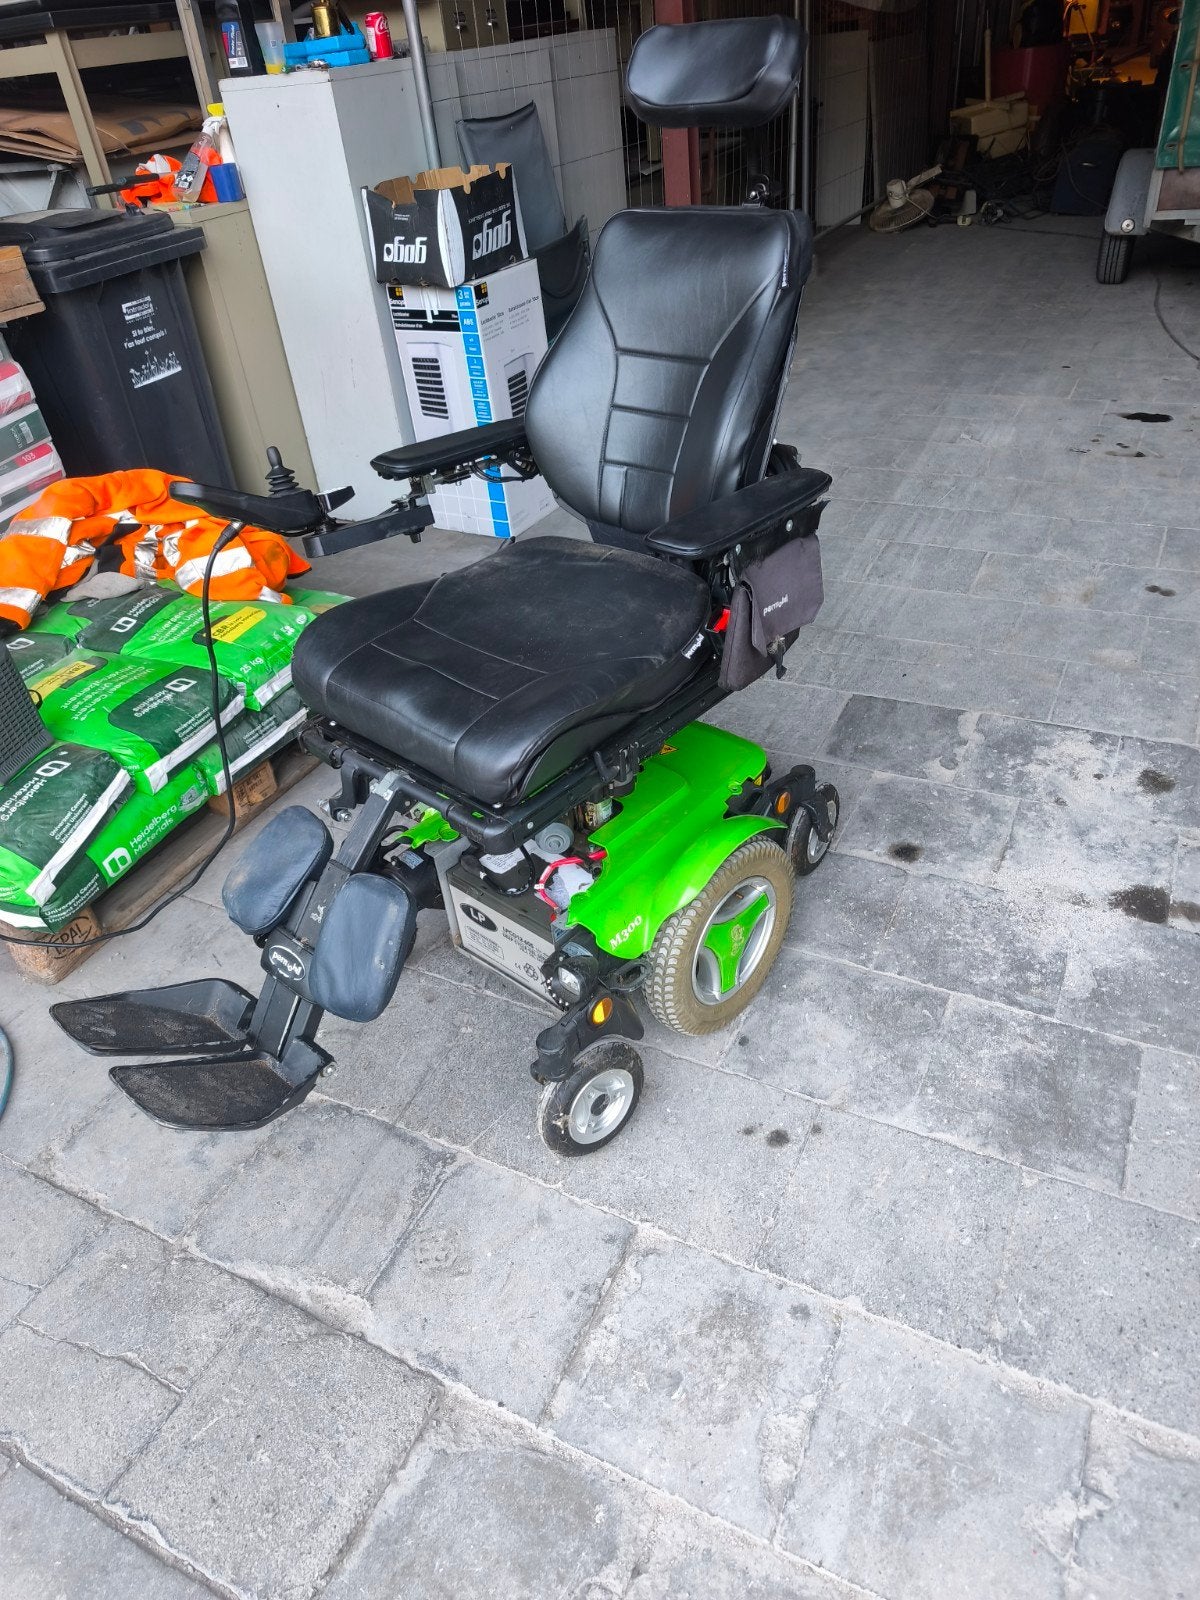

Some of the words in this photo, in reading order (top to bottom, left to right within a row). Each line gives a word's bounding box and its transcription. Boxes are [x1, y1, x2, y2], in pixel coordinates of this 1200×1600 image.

[458, 289, 463, 300] 3
[21, 452, 36, 463] 103
[240, 663, 252, 674] 25
[251, 656, 264, 667] kg
[0, 778, 48, 822] Heidelberg
[50, 810, 72, 837] Universeel
[70, 793, 88, 812] Cement
[70, 800, 90, 824] Universel
[129, 804, 178, 848] Heidelberg
[134, 817, 175, 855] Materials
[45, 892, 80, 916] Universeel
[79, 873, 100, 896] Cement
[468, 907, 487, 924] LP
[609, 914, 643, 951] M300
